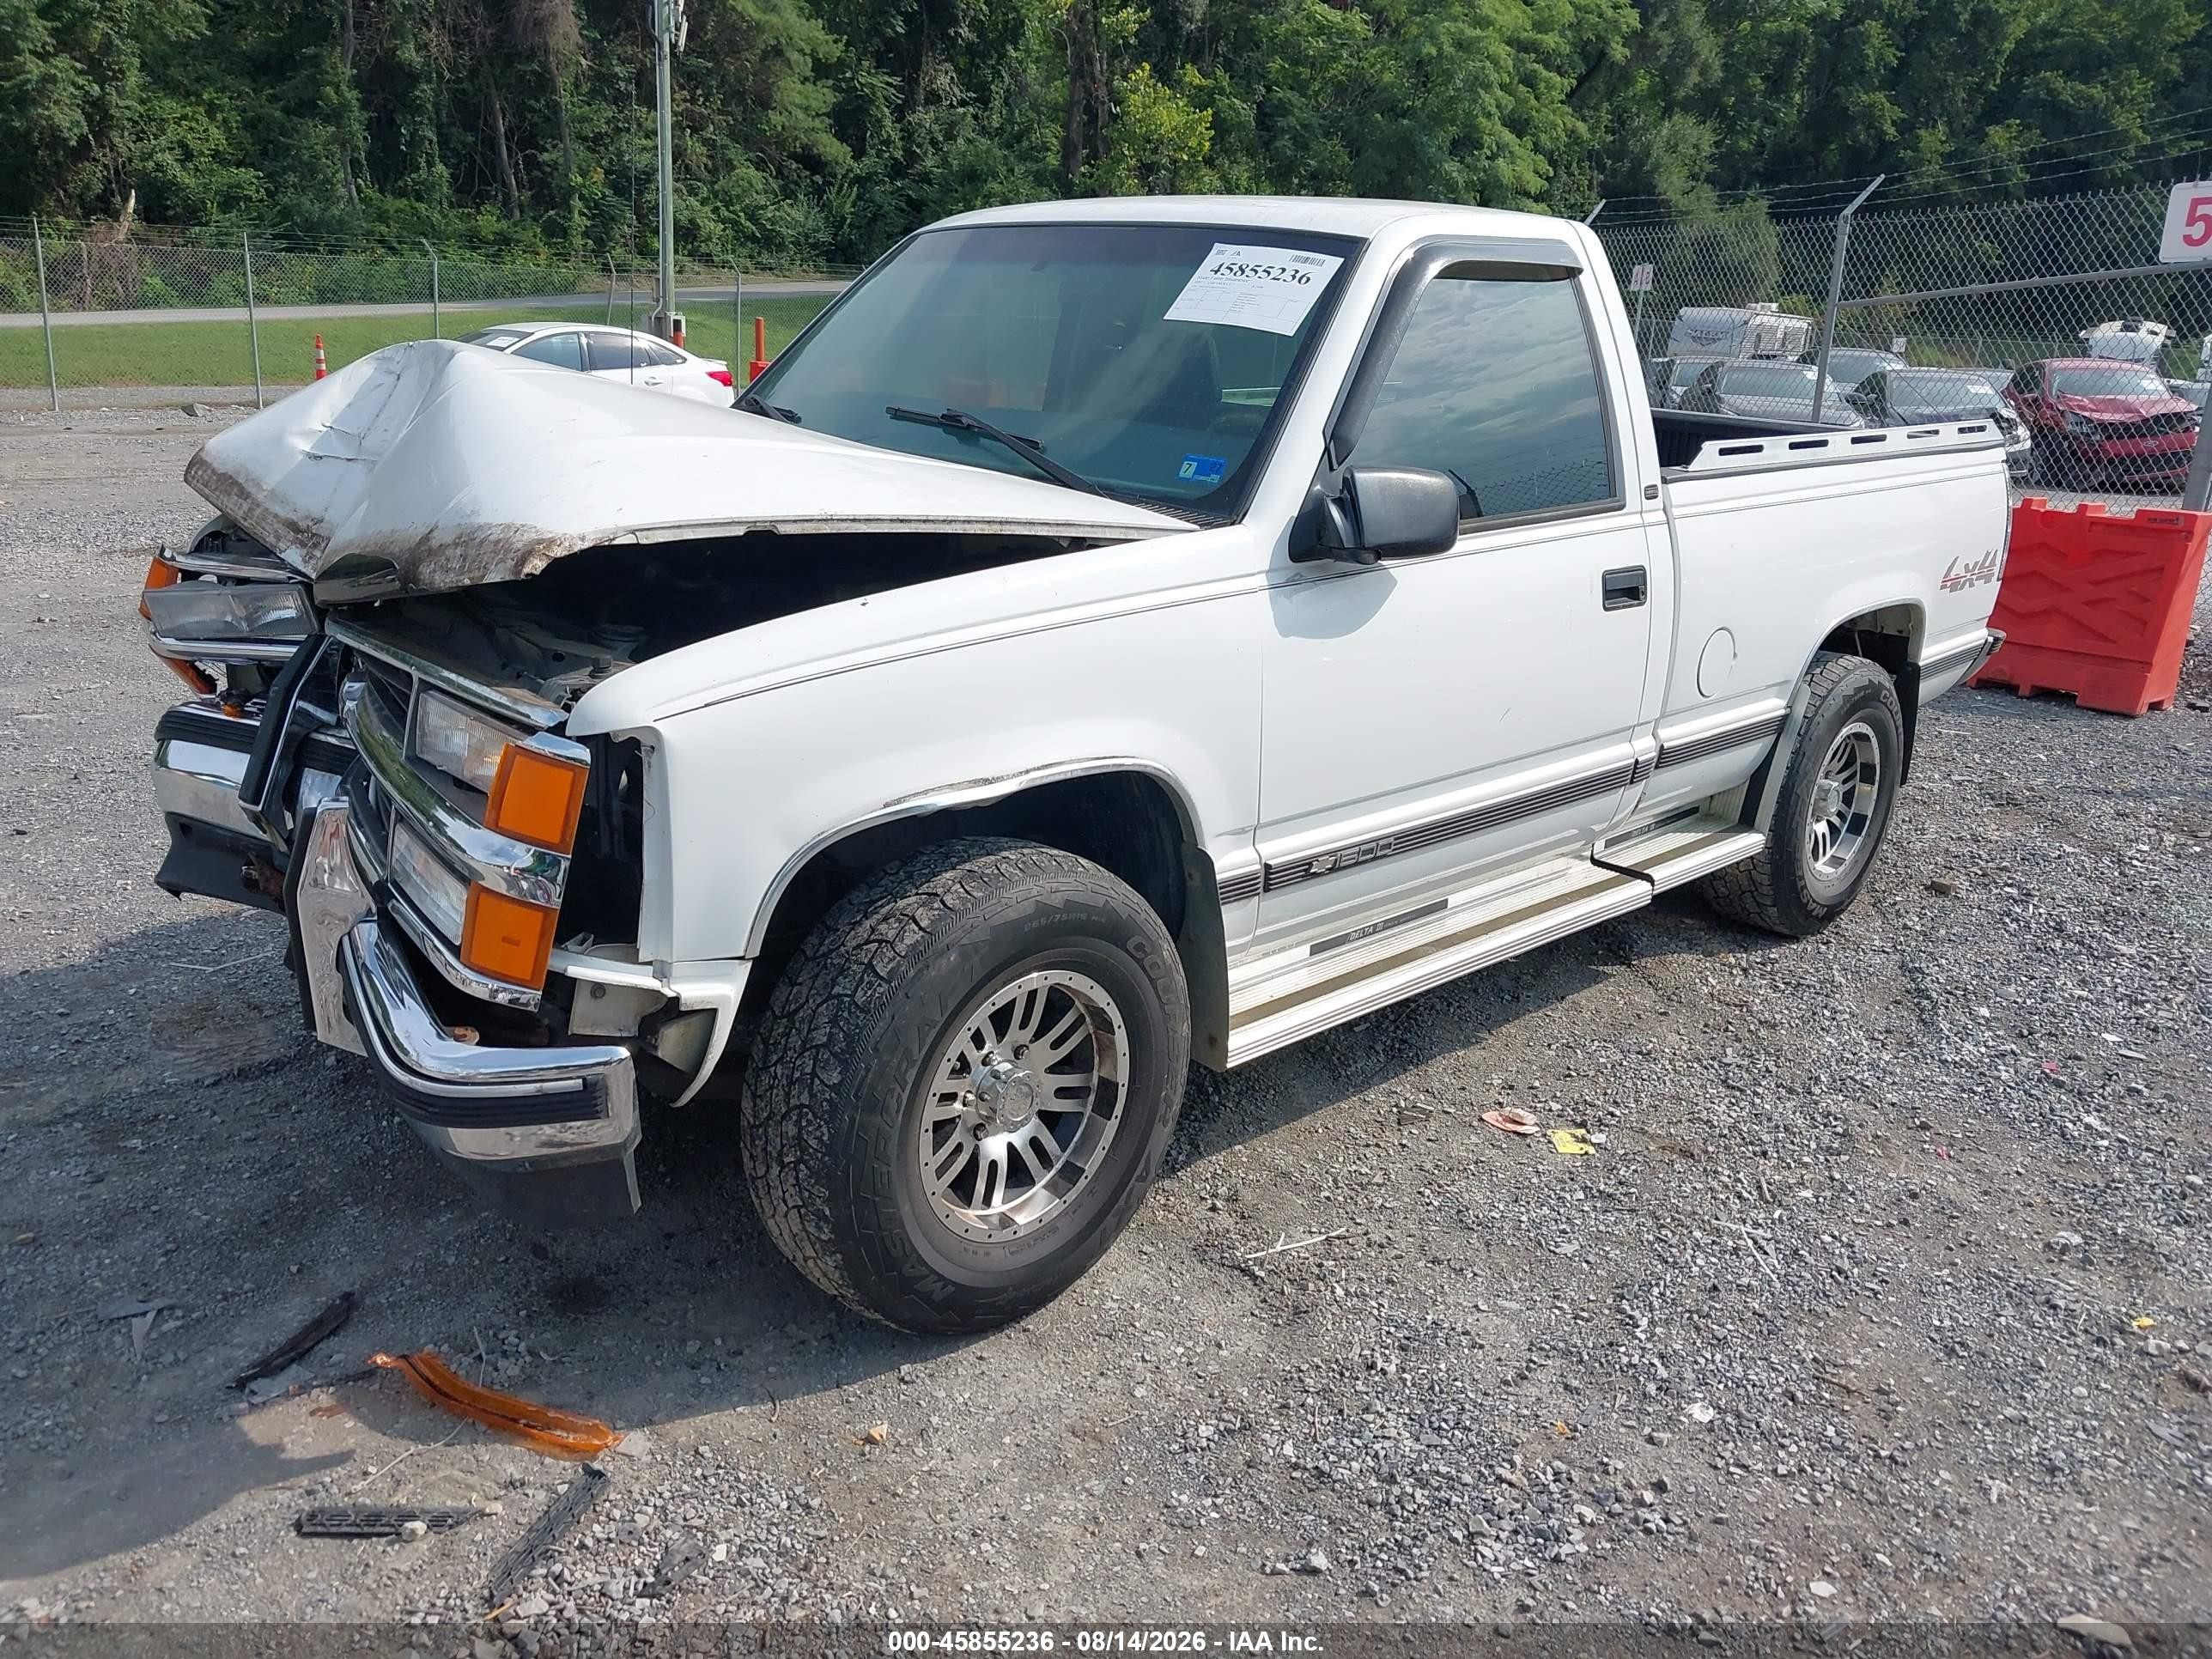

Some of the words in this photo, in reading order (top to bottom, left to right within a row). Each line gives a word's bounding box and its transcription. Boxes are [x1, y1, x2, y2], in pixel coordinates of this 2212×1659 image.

[2182, 196, 2212, 247] 5
[1210, 261, 1313, 286] 45855236
[1182, 462, 1193, 474] 7
[1209, 462, 1223, 473] 27
[1334, 836, 1395, 869] 1500
[1348, 926, 1375, 942] DELTA
